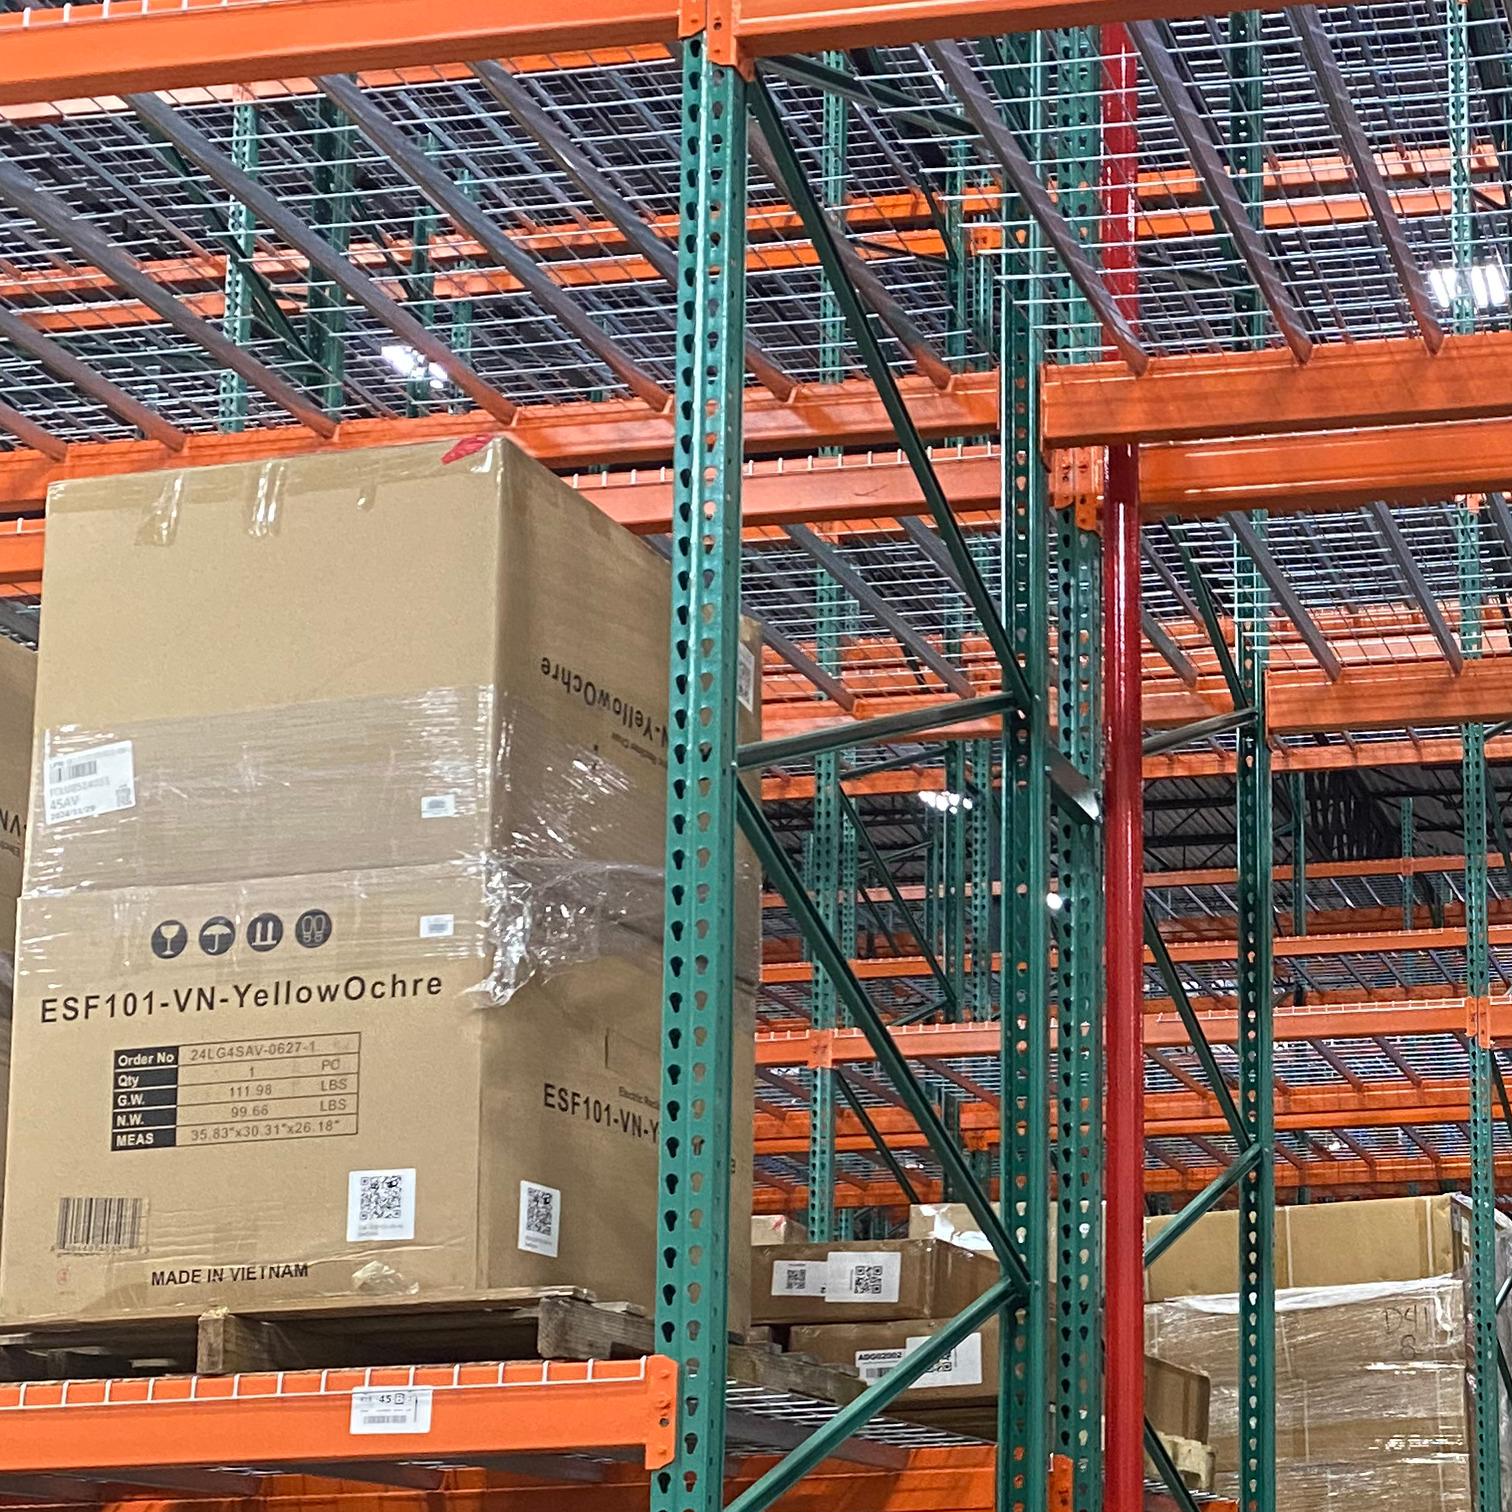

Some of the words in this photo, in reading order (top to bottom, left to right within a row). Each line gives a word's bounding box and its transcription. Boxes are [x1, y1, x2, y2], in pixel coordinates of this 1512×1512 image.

[41, 974, 442, 1023] ESF101-VN-YellowOchre
[118, 1054, 153, 1066] Order
[157, 1052, 174, 1063] No
[118, 1074, 139, 1087] Qty
[250, 1067, 254, 1078] 1
[322, 1059, 340, 1070] PC
[118, 1094, 144, 1106] G.W.
[230, 1084, 272, 1097] 111.98
[321, 1079, 347, 1091] LBS
[117, 1114, 144, 1126] N.W.
[320, 1099, 346, 1111] LBS
[117, 1134, 153, 1146] MEAS
[151, 1269, 201, 1286] MADE
[208, 1268, 223, 1283] IN
[230, 1264, 308, 1282] VIETNAM
